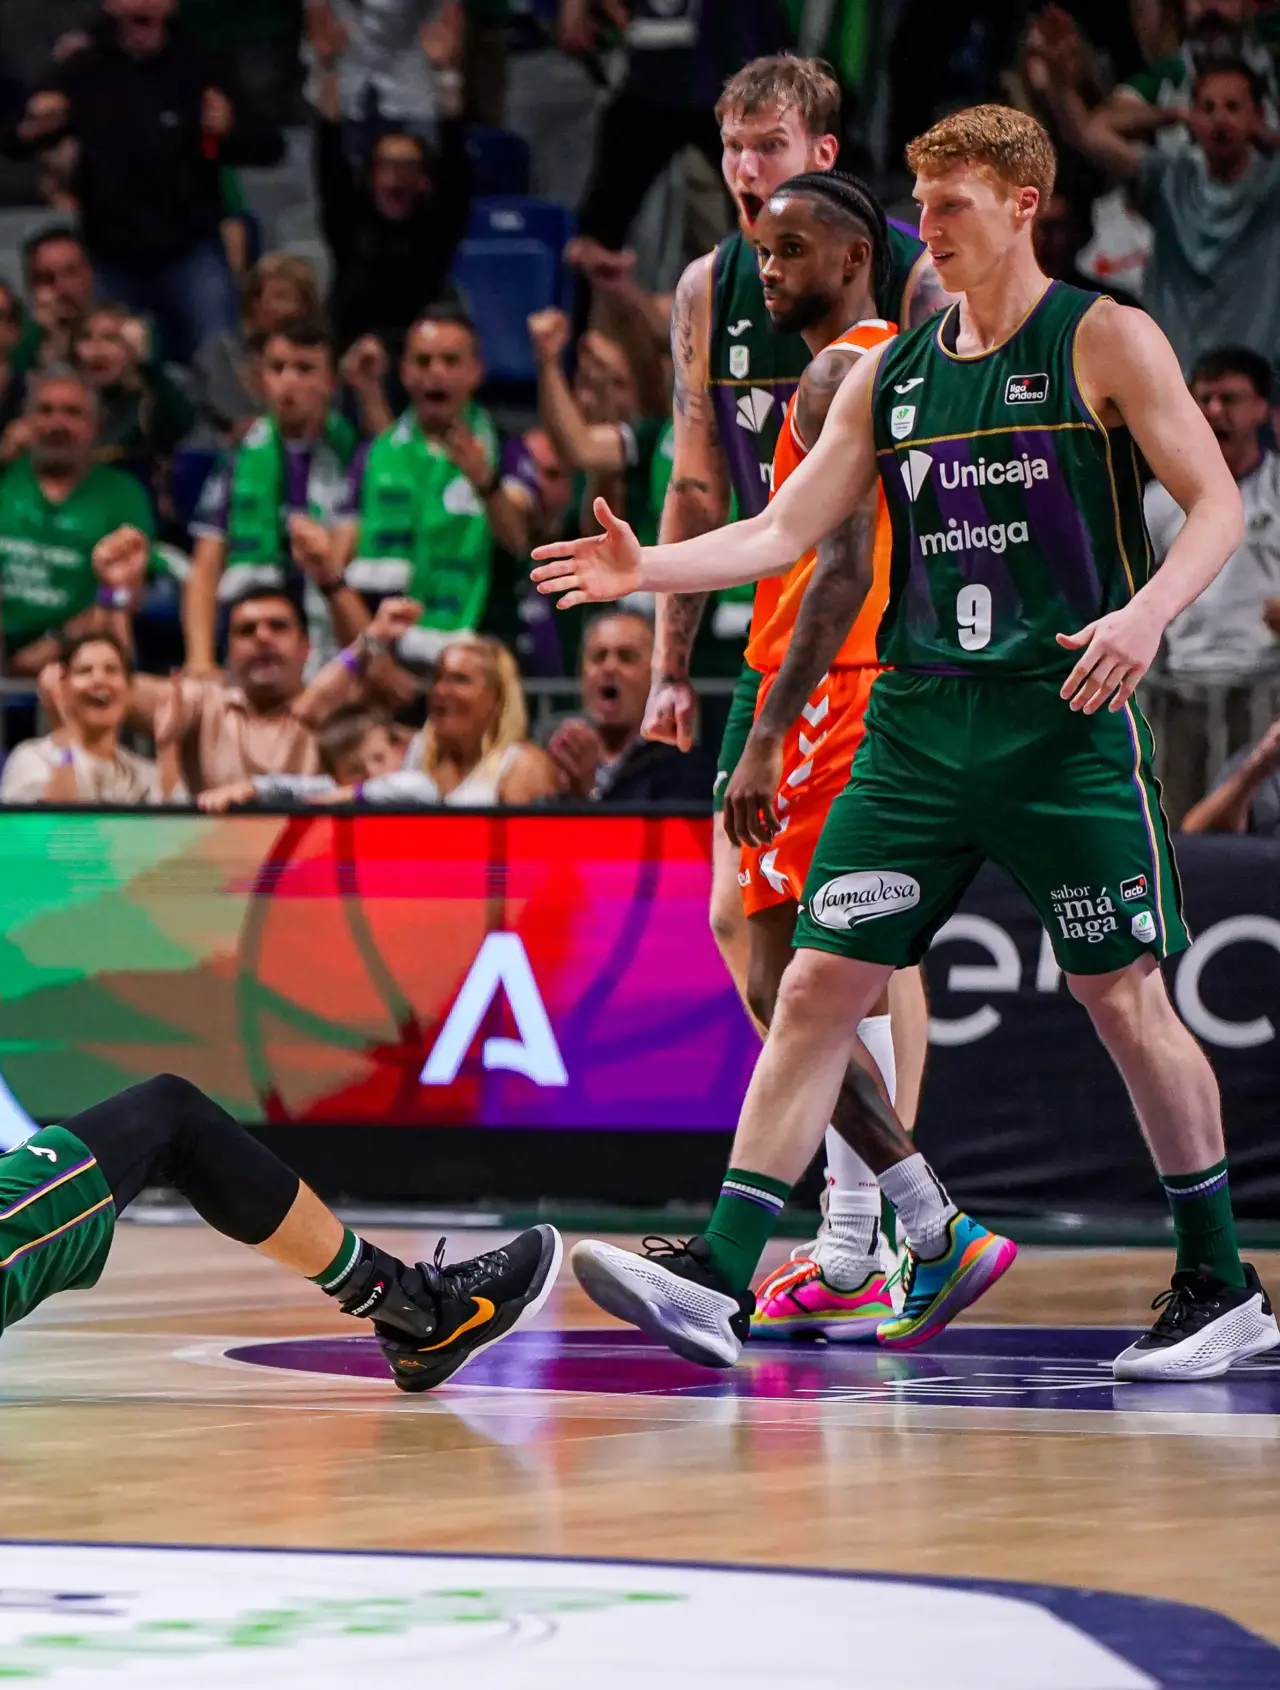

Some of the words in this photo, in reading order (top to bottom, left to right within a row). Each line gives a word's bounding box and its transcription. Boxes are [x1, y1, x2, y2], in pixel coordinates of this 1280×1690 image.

[1009, 391, 1043, 400] endesa
[939, 453, 1049, 490] Unicaja
[957, 584, 992, 651] 9
[817, 876, 915, 916] famadesa
[1050, 884, 1091, 900] sabor
[1124, 885, 1143, 898] acb
[1057, 915, 1119, 943] laga
